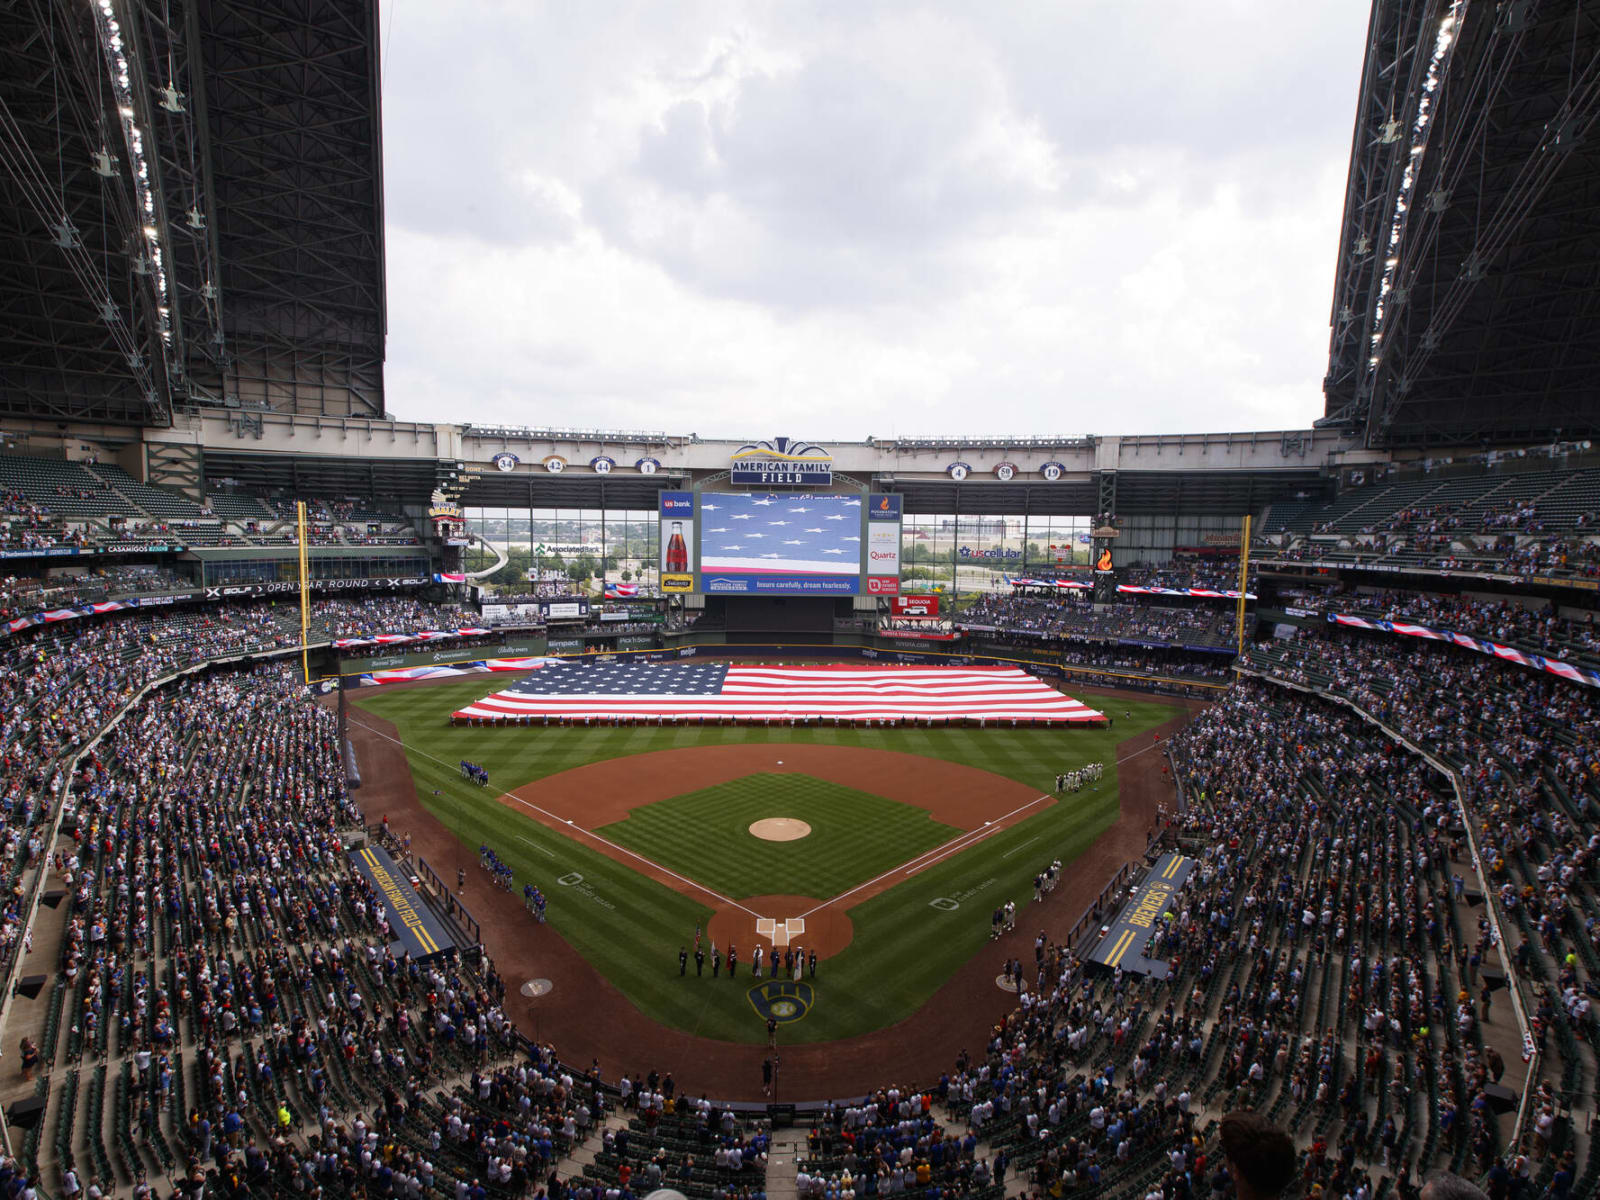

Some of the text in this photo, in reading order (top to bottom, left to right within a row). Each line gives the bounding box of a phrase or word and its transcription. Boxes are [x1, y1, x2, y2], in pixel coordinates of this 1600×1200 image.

[500, 460, 512, 468] 34
[549, 461, 561, 470] 42
[597, 463, 608, 471] 44
[733, 462, 831, 472] AMERICAN FAMILY
[956, 469, 961, 477] 4
[1048, 468, 1058, 477] 19
[762, 474, 802, 483] FIELD
[870, 551, 896, 560] Quartz
[268, 582, 294, 592] OPEN
[328, 579, 369, 588] ROUND
[370, 864, 397, 894] AMERICAN
[386, 889, 411, 911] FAMILY
[399, 908, 422, 928] FIELD
[1128, 889, 1168, 928] BREWERS
